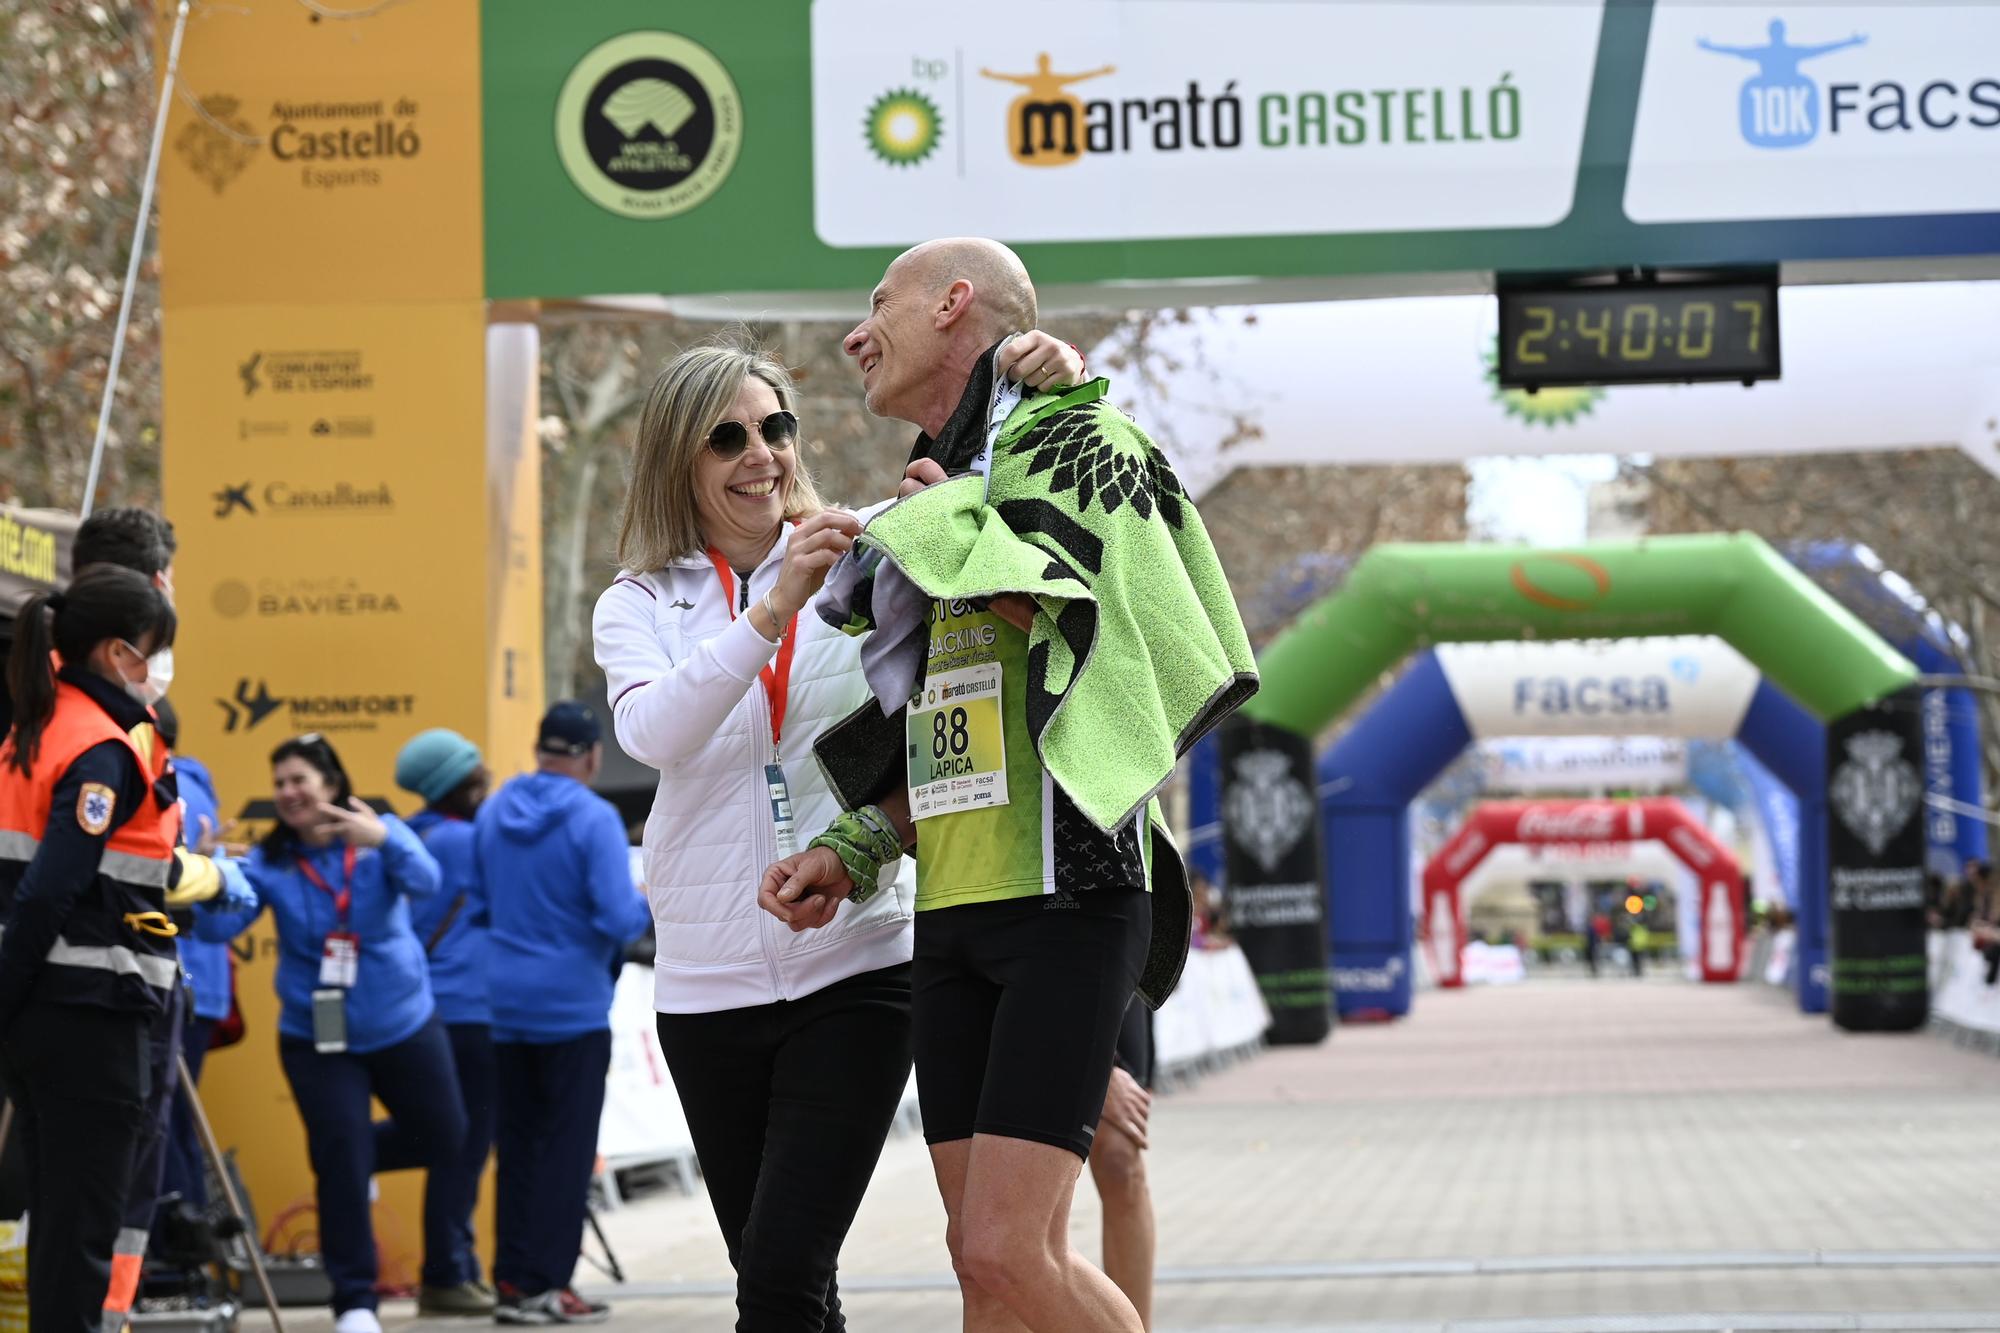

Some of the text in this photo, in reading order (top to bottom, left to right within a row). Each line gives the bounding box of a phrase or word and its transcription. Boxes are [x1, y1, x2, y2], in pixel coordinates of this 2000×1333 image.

[269, 97, 419, 122] Ajuntament de
[1020, 71, 1522, 157] marató CASTELLÓ
[1749, 86, 1813, 137] 10K
[269, 119, 421, 162] Castelló
[301, 166, 381, 188] Esports
[258, 593, 402, 617] BAVIERA
[288, 694, 416, 717] MONFORT
[933, 706, 969, 760] 88
[930, 756, 974, 780] LAPICA
[1043, 901, 1080, 910] adidas
